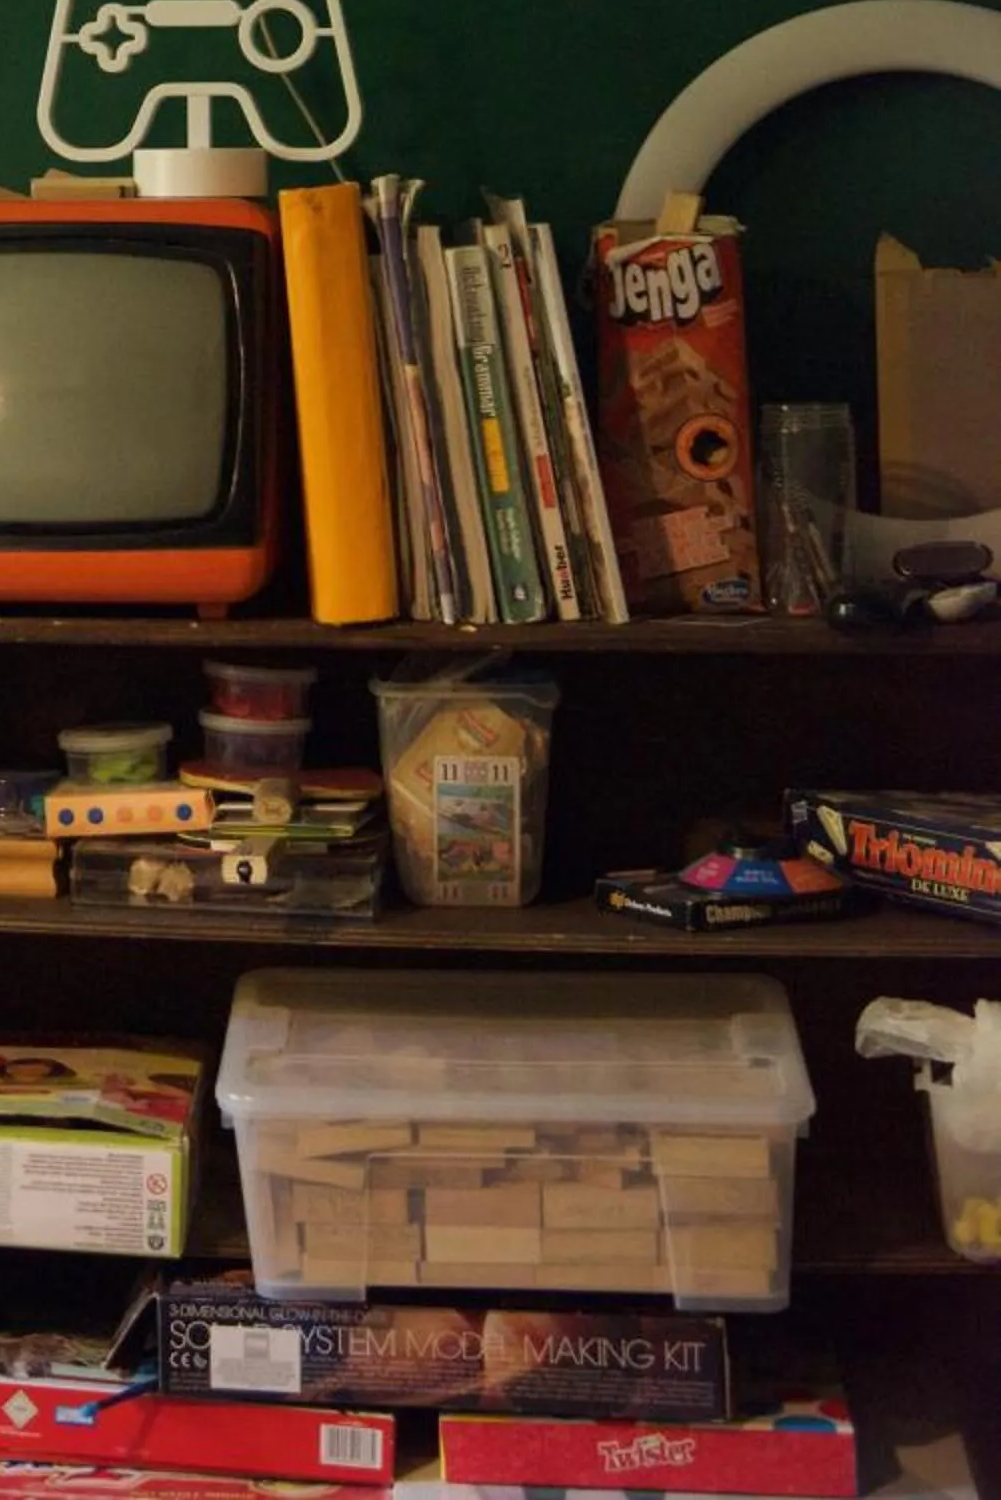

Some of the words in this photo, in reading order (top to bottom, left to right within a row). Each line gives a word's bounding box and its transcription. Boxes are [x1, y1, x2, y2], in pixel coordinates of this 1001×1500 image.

[609, 242, 723, 322] Jenga
[472, 344, 497, 418] Grammar
[441, 763, 458, 781] 11
[492, 764, 509, 782] 11
[933, 882, 970, 902] LUXE
[283, 1322, 397, 1357] YSTEM
[523, 1334, 655, 1370] MAKING
[664, 1339, 707, 1372] KIT
[598, 1432, 695, 1473] Twister
